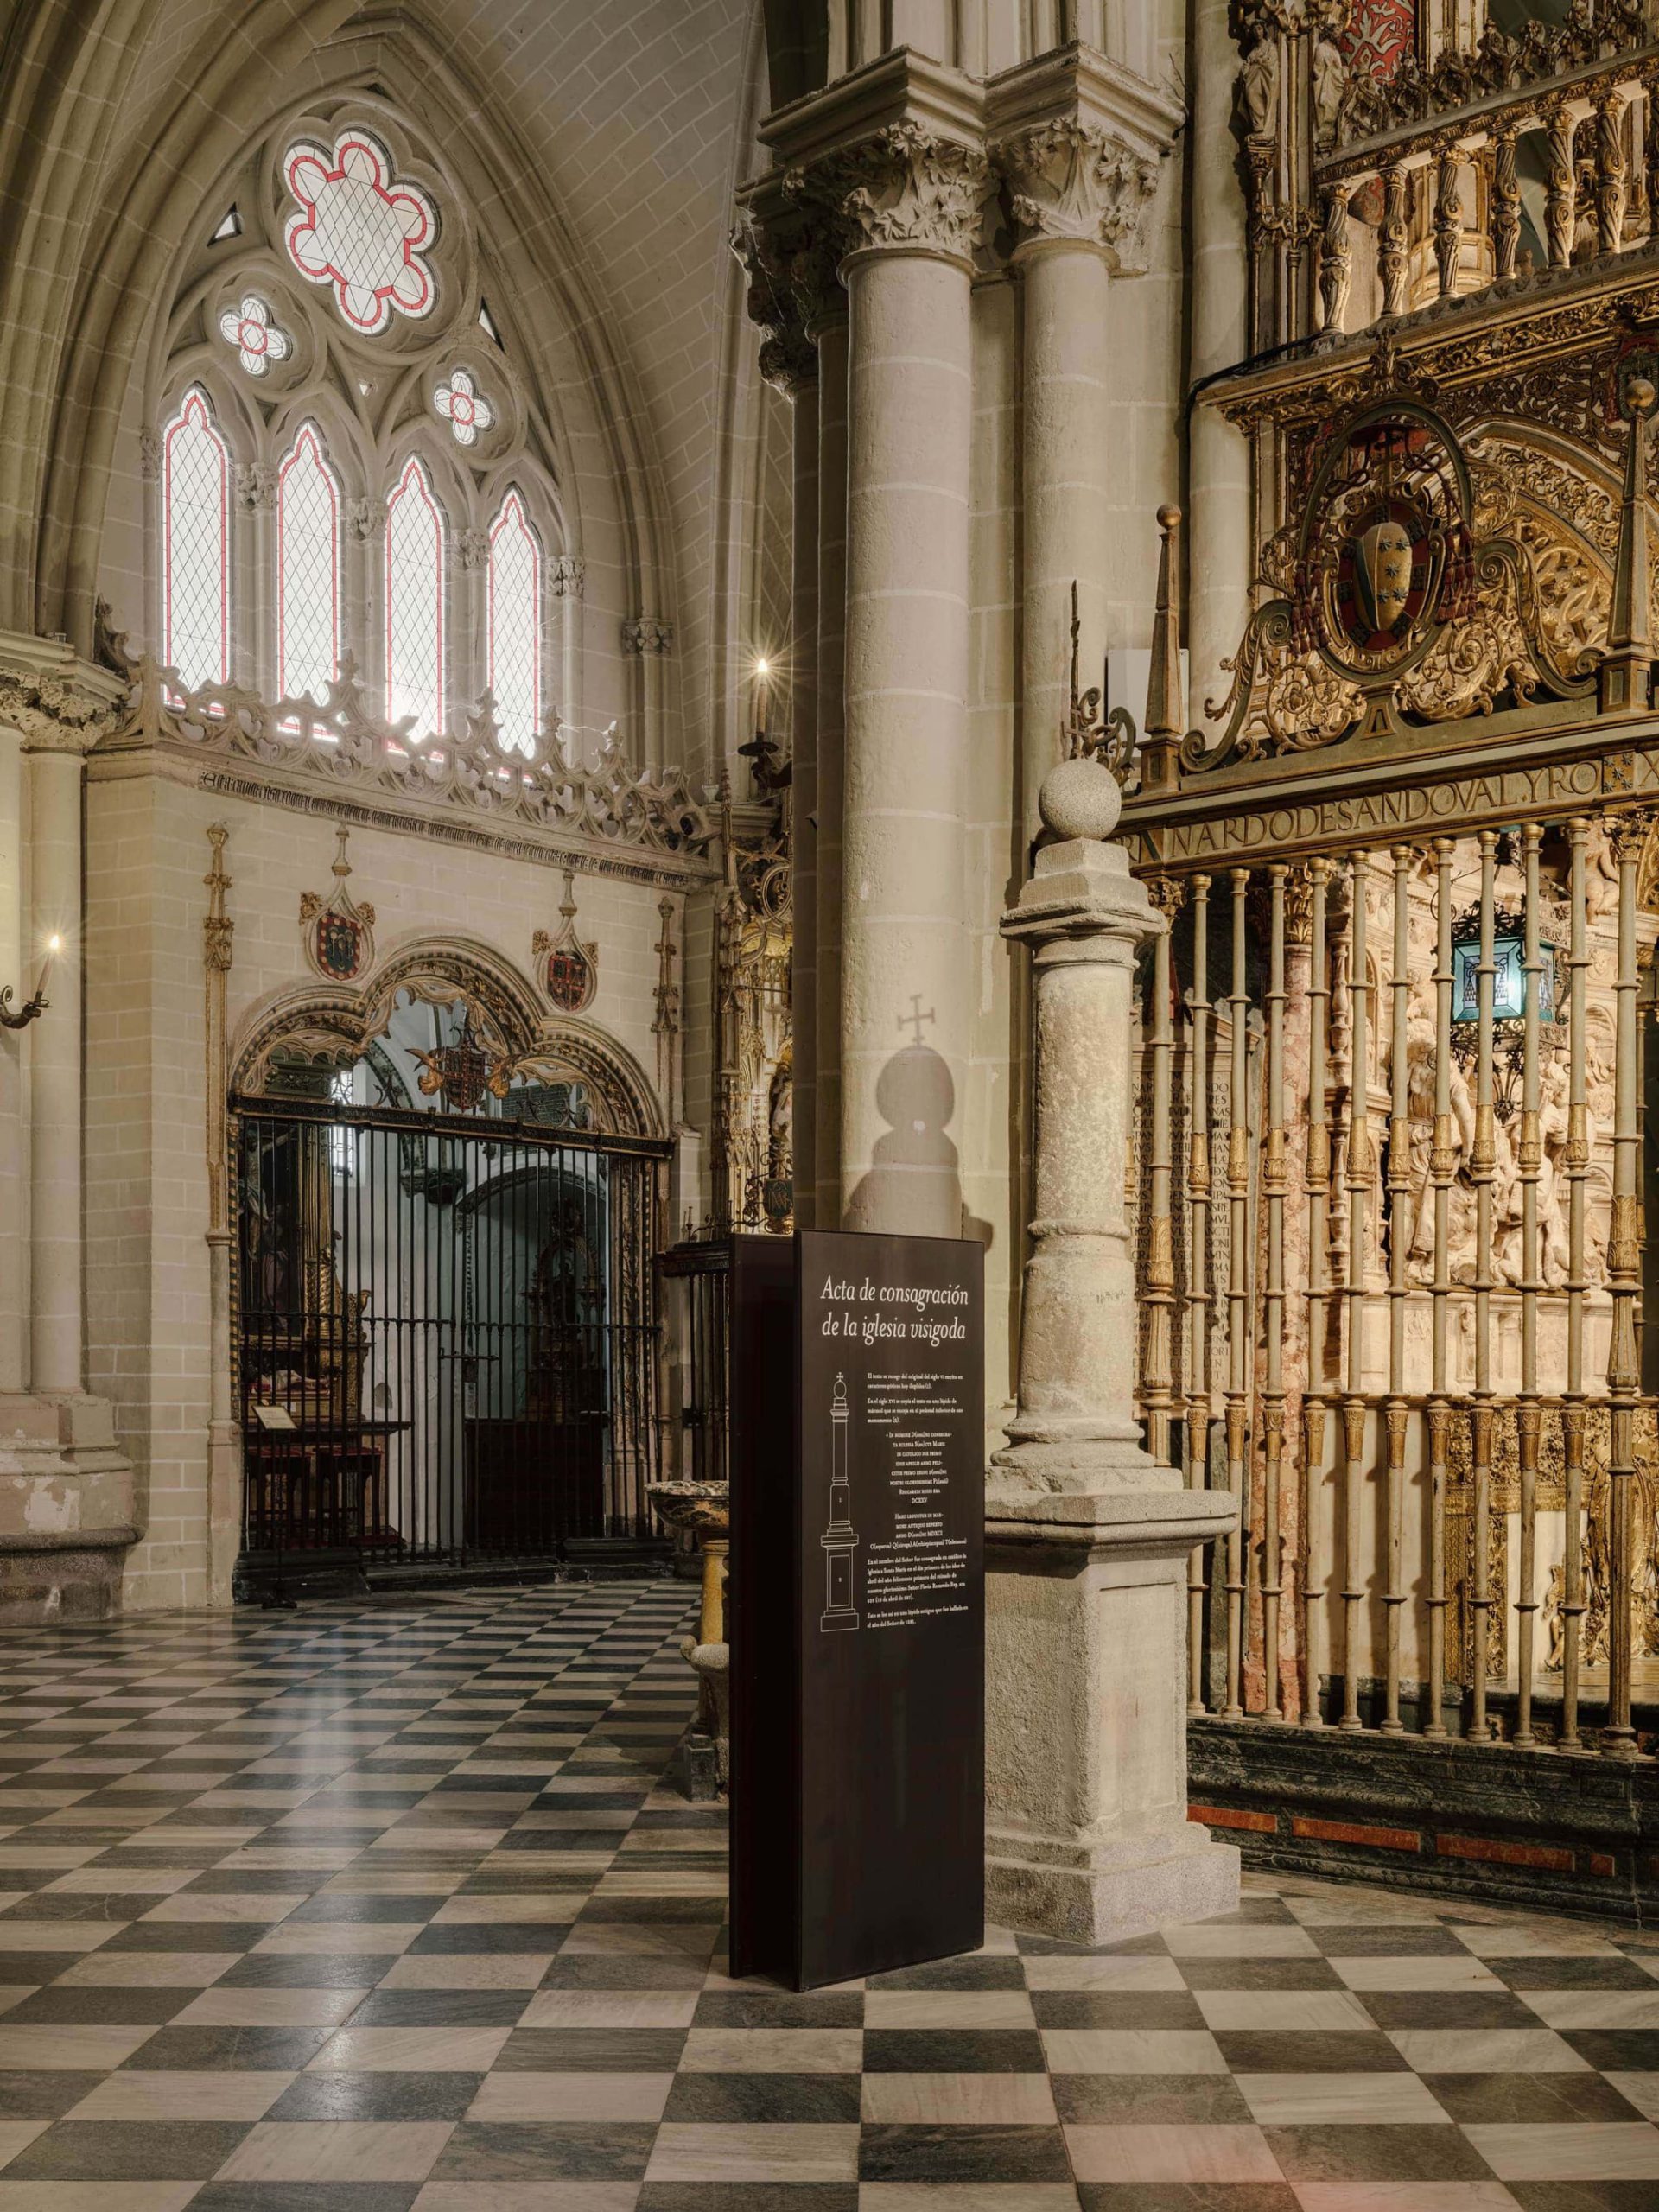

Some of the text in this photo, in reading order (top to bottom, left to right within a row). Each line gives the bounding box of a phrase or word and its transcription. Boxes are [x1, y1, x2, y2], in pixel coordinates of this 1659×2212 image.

[820, 1274, 969, 1312] Acta de consagración
[822, 1312, 966, 1347] de la iglesia visigoda
